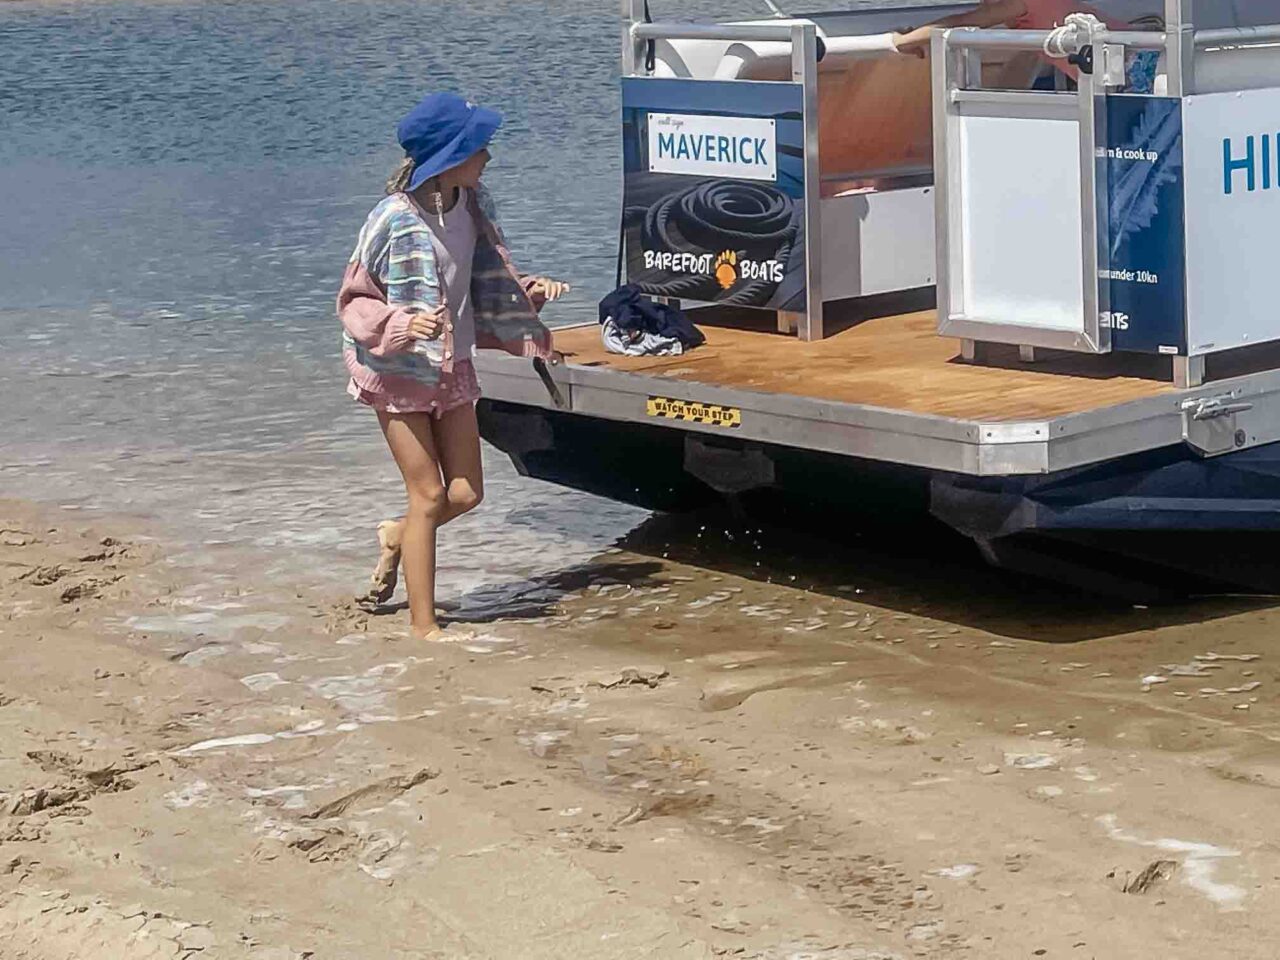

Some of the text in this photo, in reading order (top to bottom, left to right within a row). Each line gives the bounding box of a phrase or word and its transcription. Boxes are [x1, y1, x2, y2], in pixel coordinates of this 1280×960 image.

[658, 132, 768, 166] MAVERICK
[1123, 147, 1145, 160] cook
[1146, 151, 1158, 164] up
[643, 250, 784, 283] BAREFOOT BOATS
[1110, 268, 1135, 281] under
[655, 402, 734, 421] WATCH YOUR STEP
